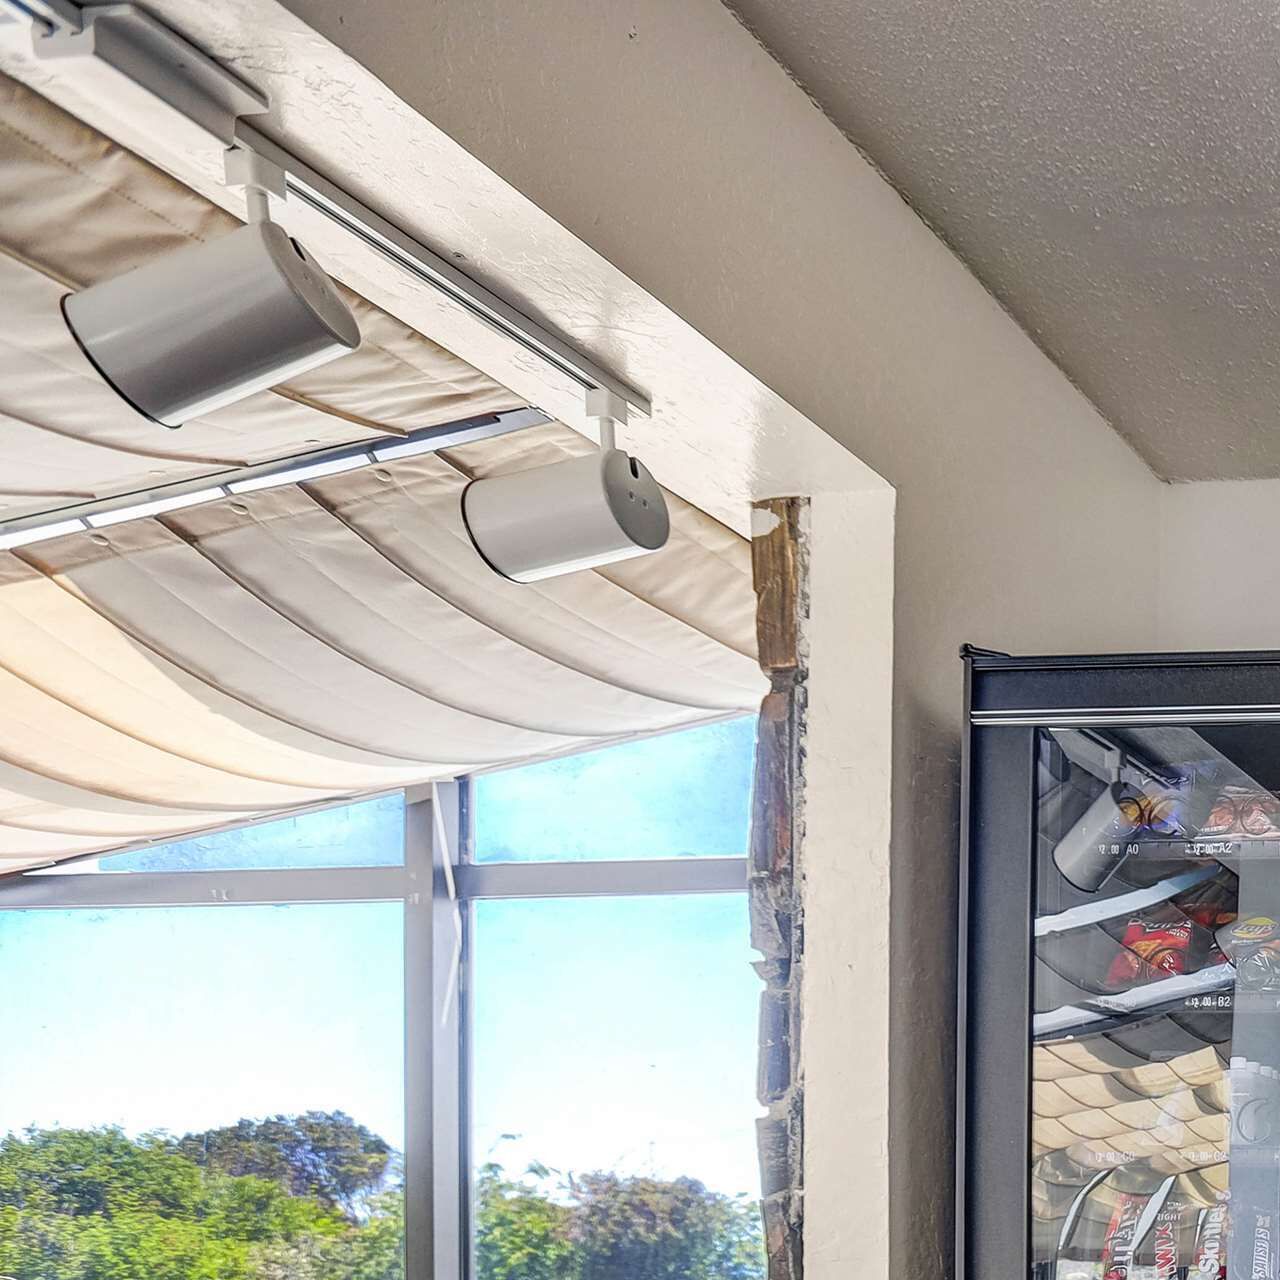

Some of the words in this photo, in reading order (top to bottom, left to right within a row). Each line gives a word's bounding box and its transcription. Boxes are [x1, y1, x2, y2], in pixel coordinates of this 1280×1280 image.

[1126, 843, 1139, 854] A0
[1219, 842, 1232, 853] A2
[1217, 996, 1231, 1006] B2
